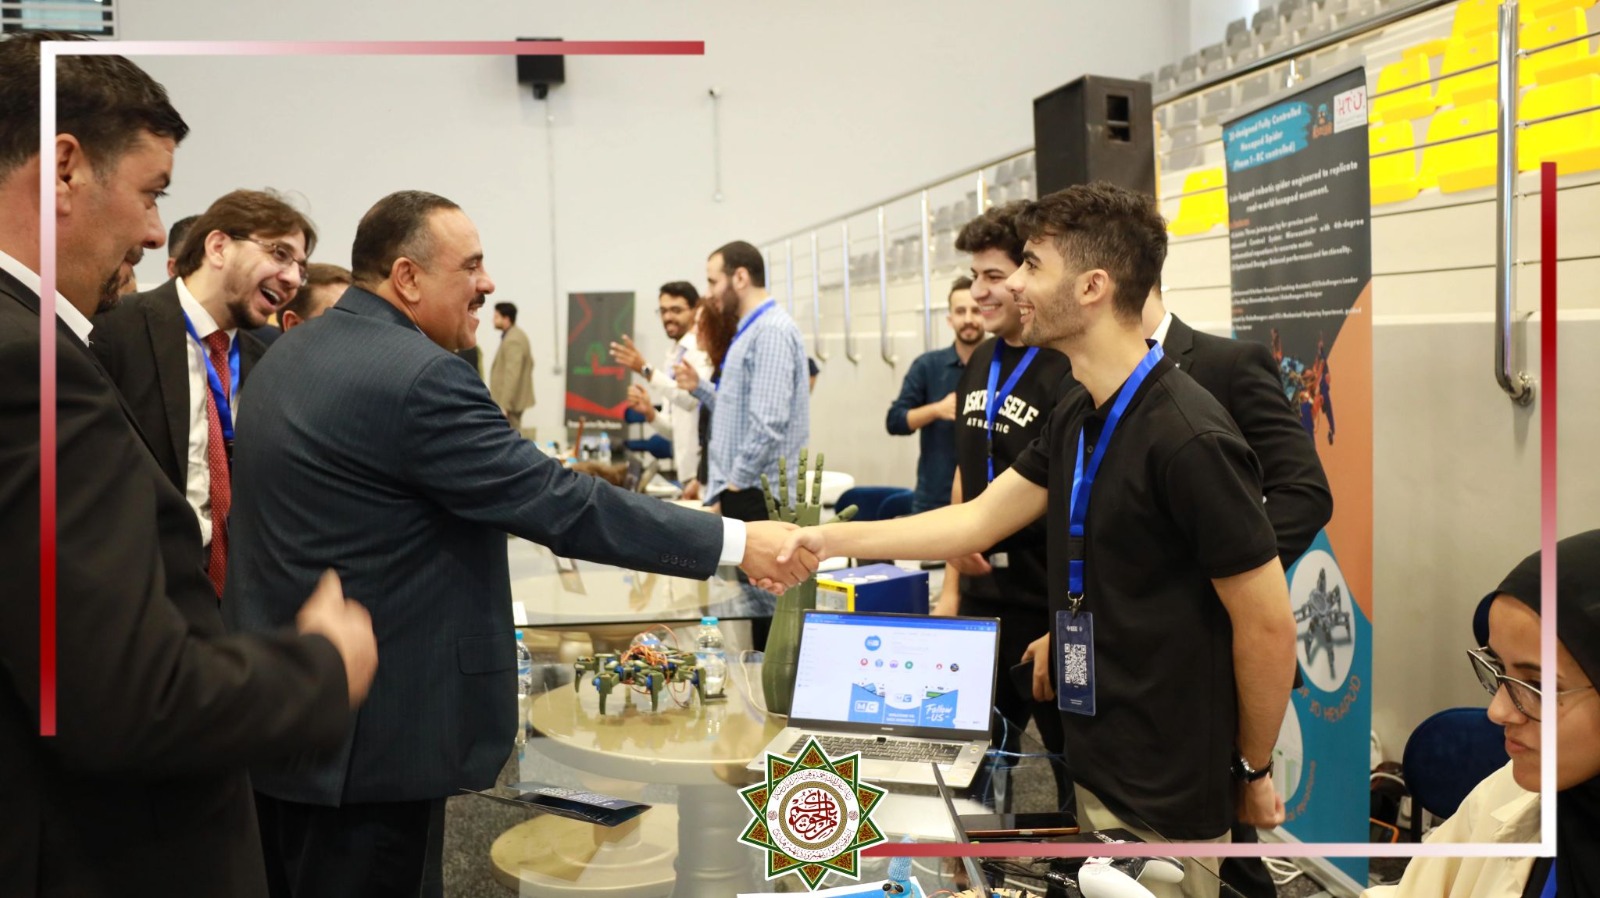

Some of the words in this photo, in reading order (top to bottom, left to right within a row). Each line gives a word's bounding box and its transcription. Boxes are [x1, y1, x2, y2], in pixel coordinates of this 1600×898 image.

[1272, 107, 1301, 123] Controlled
[1265, 130, 1283, 143] Spider
[1291, 171, 1321, 187] engineered
[1329, 160, 1358, 175] replicate
[1299, 186, 1329, 198] movement.
[966, 417, 1010, 434] ATHLTIC
[925, 703, 953, 715] Follow
[930, 713, 945, 722] US
